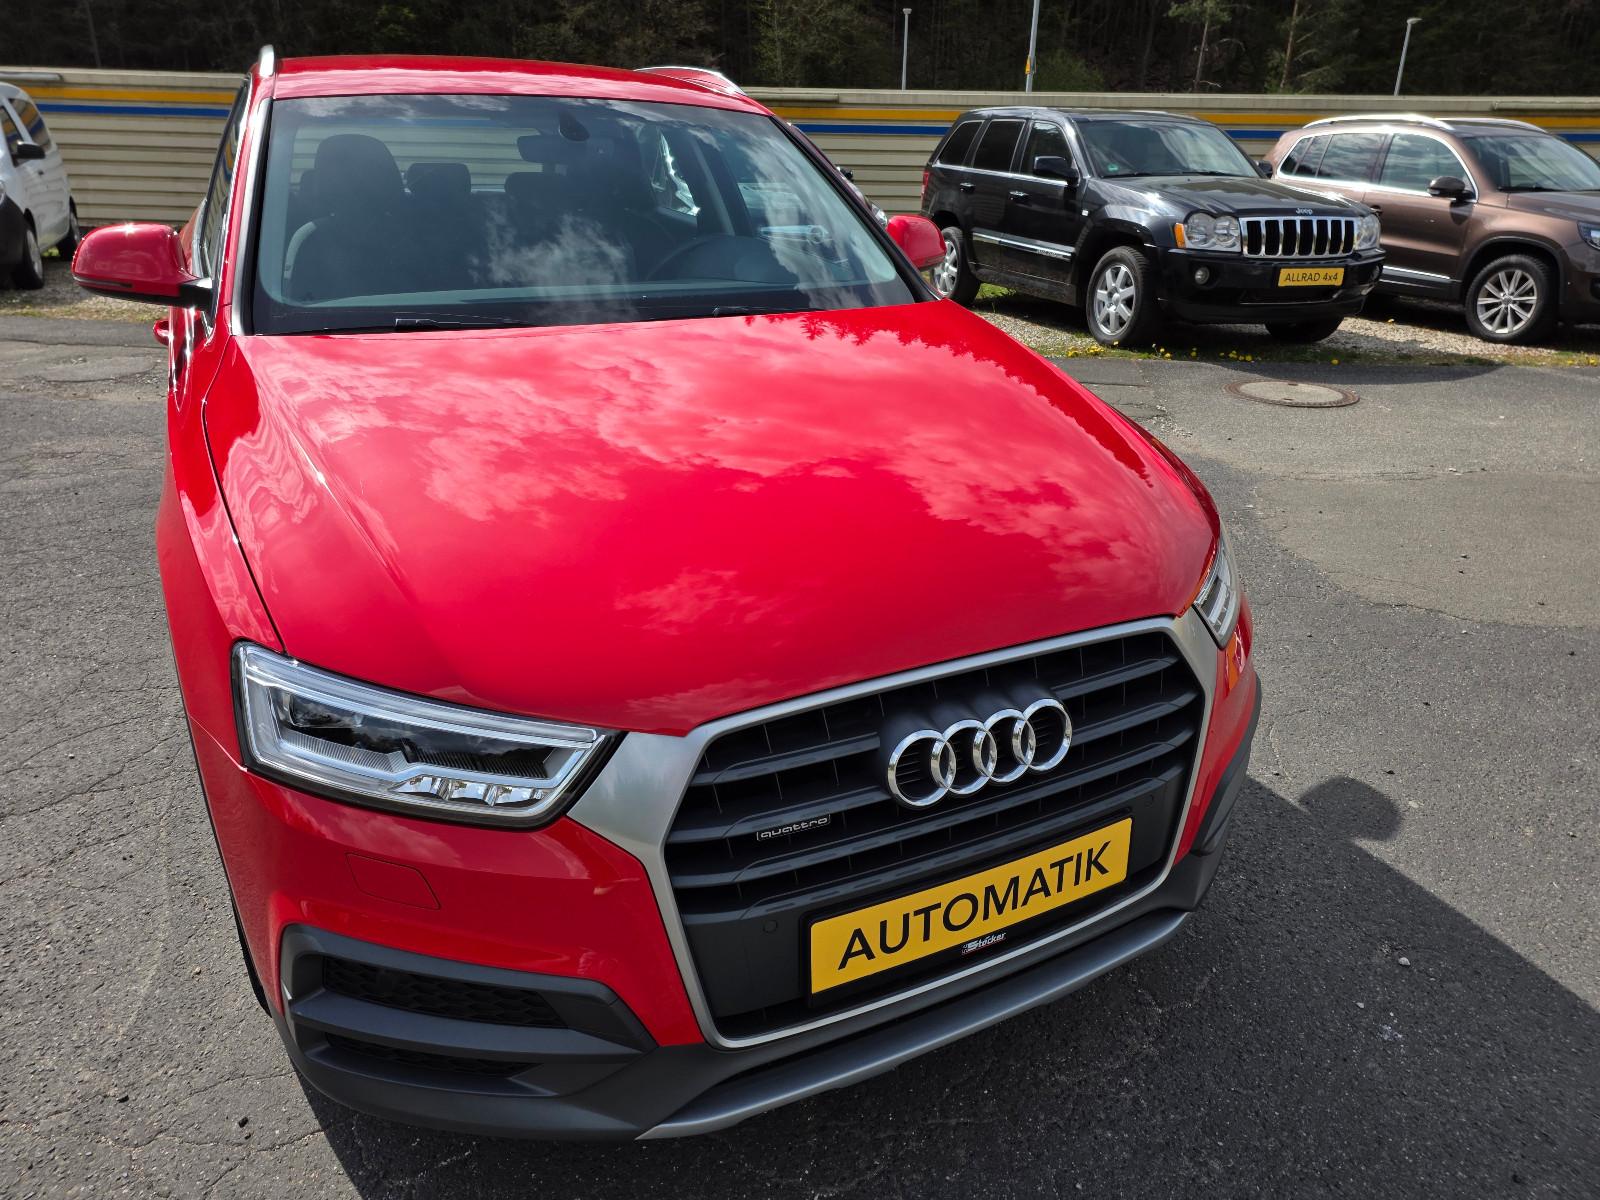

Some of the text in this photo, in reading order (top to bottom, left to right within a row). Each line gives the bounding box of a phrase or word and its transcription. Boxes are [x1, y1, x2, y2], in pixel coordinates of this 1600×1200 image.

[1295, 207, 1313, 216] Jeep
[1285, 272, 1338, 282] ALLRAD 4x4
[760, 817, 828, 838] quattro
[837, 840, 1111, 971] AUTOMATIK
